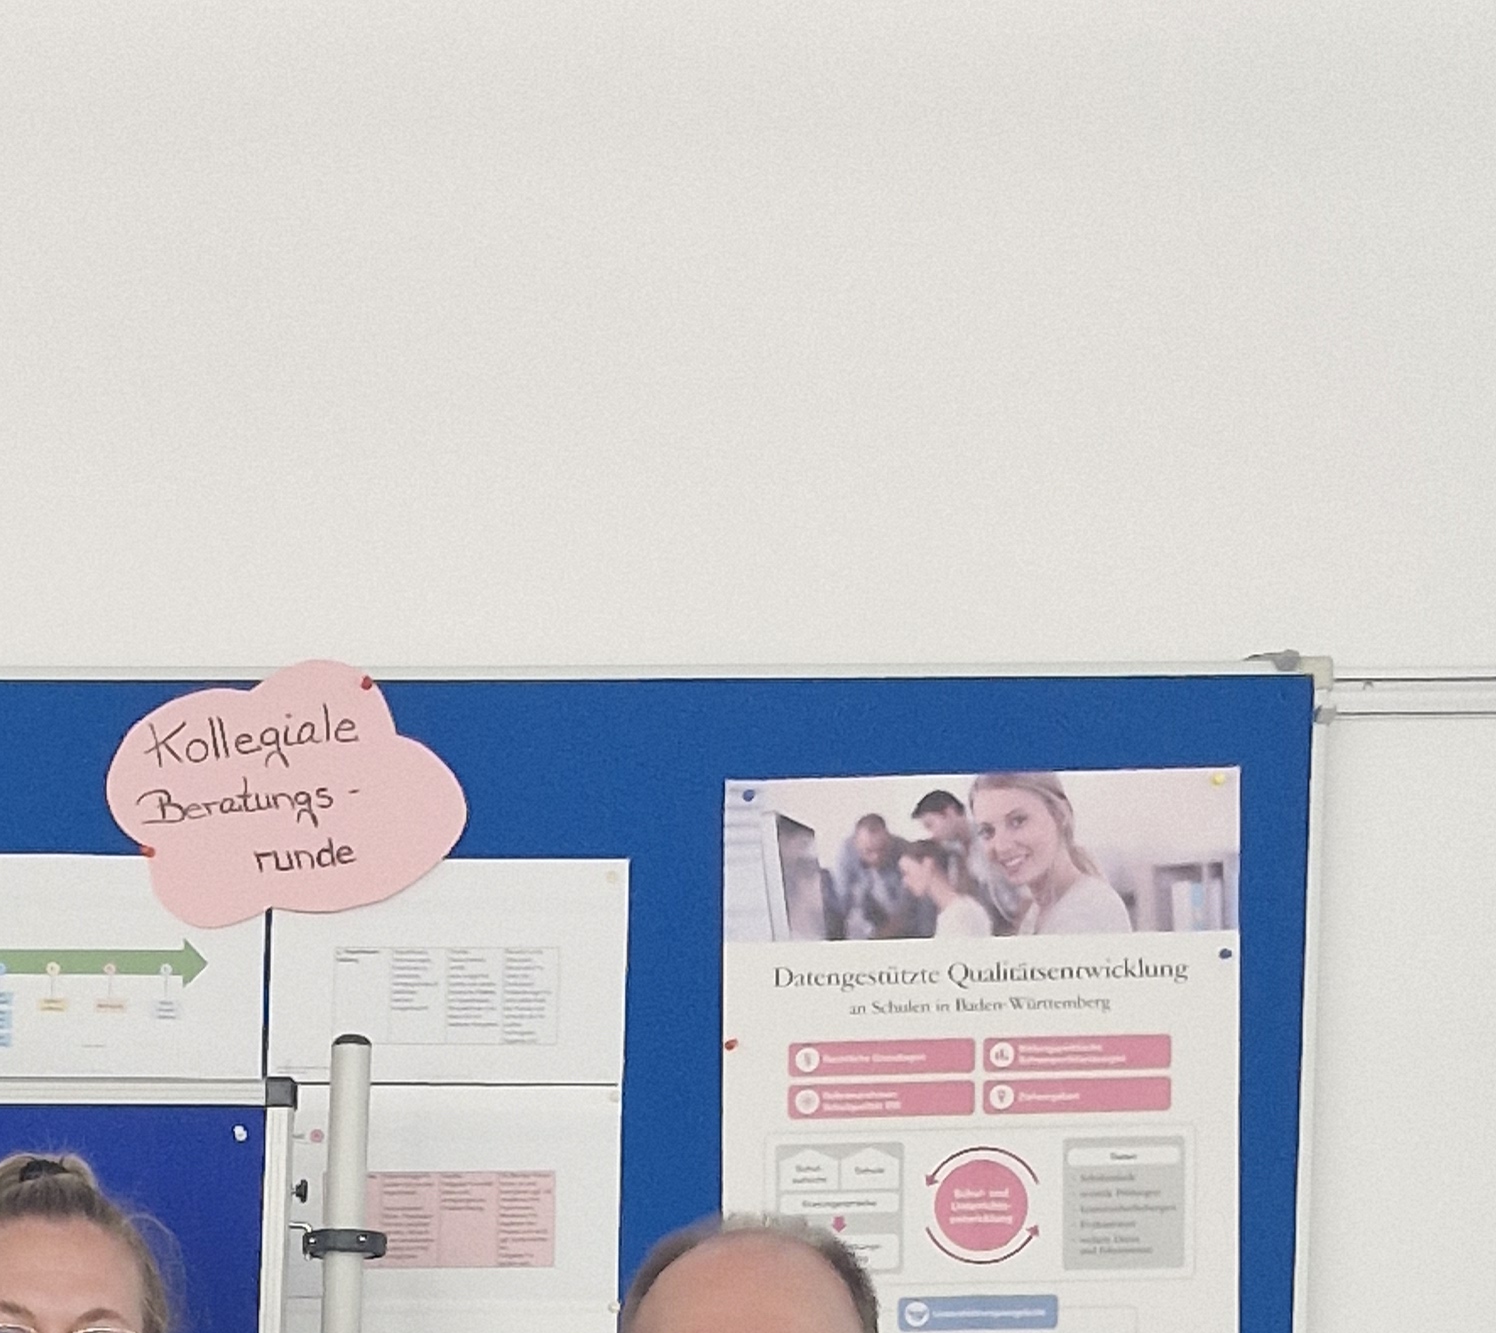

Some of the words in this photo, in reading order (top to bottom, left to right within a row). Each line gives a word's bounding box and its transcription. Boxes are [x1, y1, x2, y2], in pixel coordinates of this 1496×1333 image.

[143, 703, 359, 768] Kollegiale
[254, 837, 357, 873] runde
[774, 965, 940, 993] Datengestützte
[947, 957, 1190, 990] Qualitätsentwicklung
[849, 1005, 866, 1015] an
[871, 999, 931, 1014] Schulen
[936, 999, 950, 1013] in
